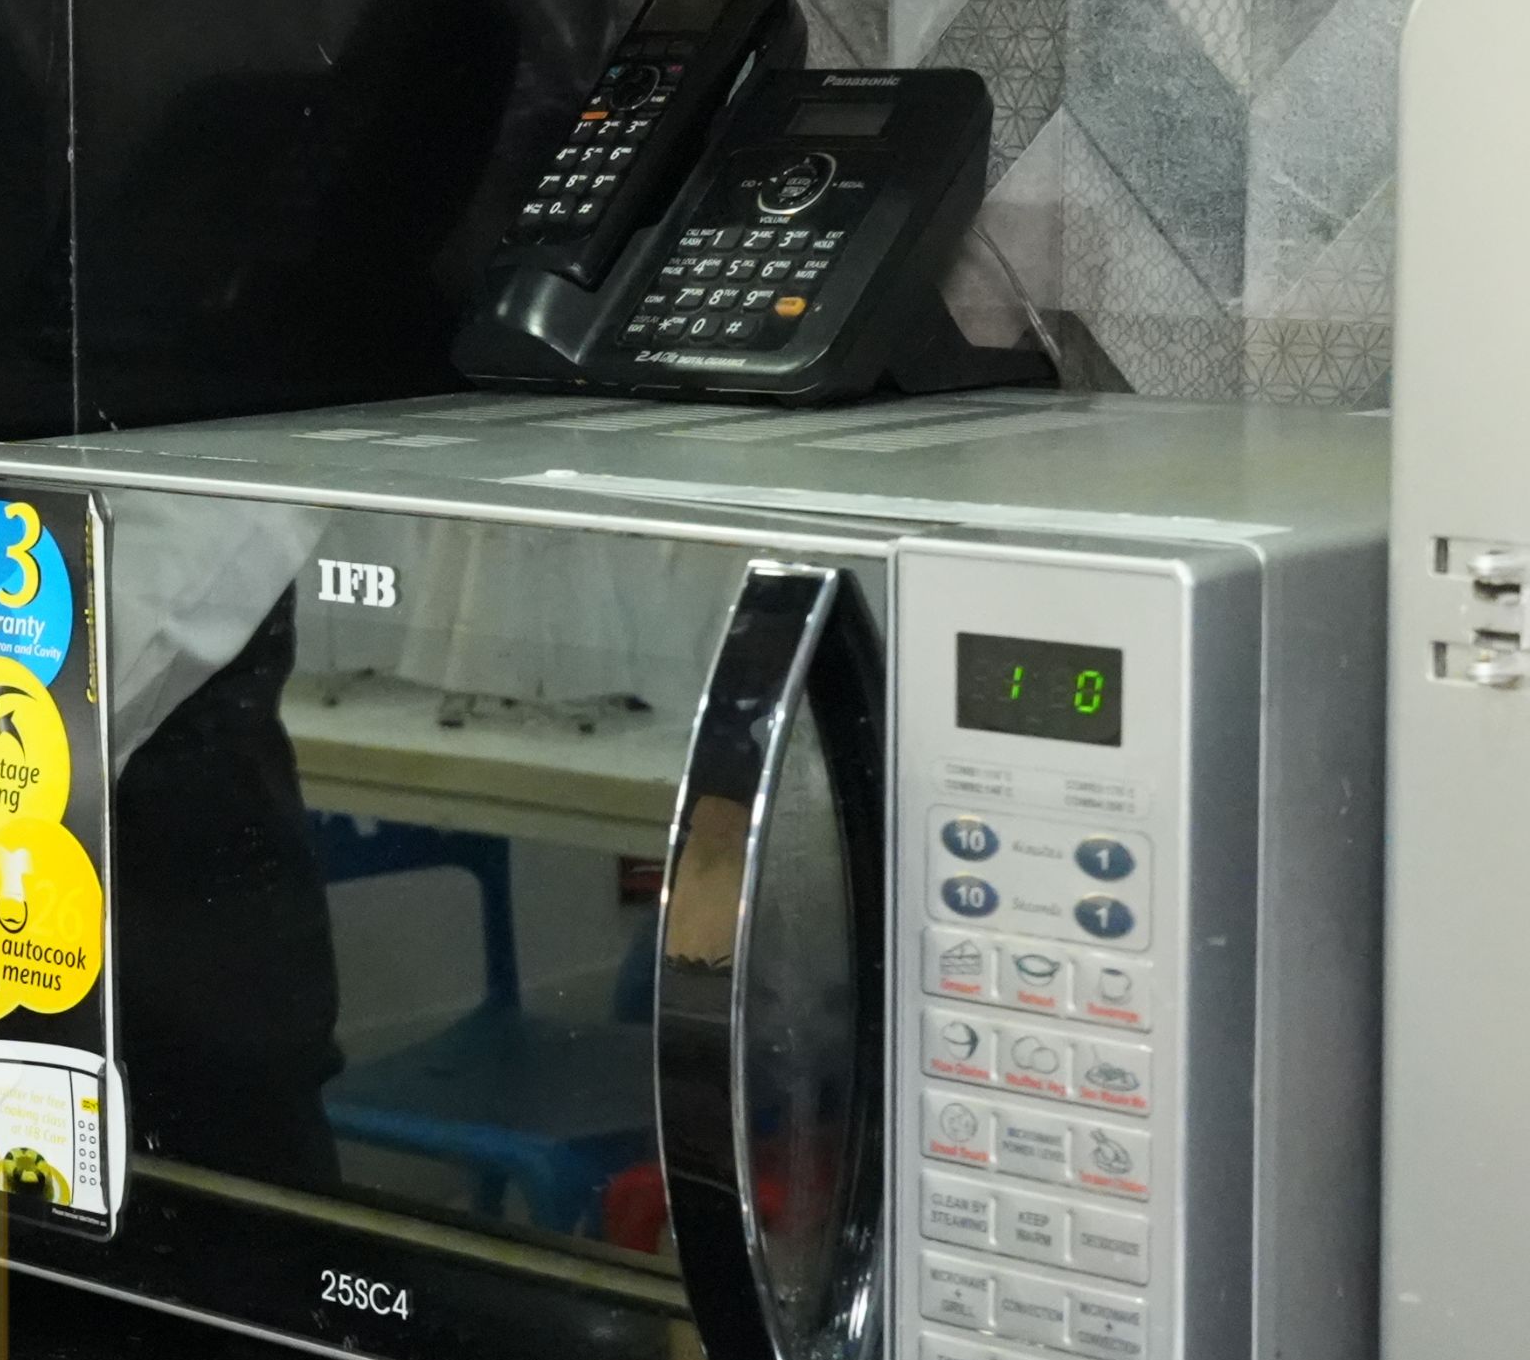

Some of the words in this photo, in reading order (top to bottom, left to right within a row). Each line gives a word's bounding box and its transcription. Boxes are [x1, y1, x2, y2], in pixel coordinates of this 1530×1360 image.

[822, 75, 901, 87] Panasonic
[713, 230, 725, 246] 1
[318, 559, 396, 608] IFB
[14, 642, 32, 655] and
[34, 644, 63, 662] Cavity
[956, 830, 986, 853] 10
[1095, 848, 1110, 872] 1
[956, 886, 985, 909] 10
[1095, 907, 1109, 930] 1
[1, 937, 87, 971] autocook
[1, 963, 62, 992] menus
[321, 1269, 409, 1321] 25SC4
